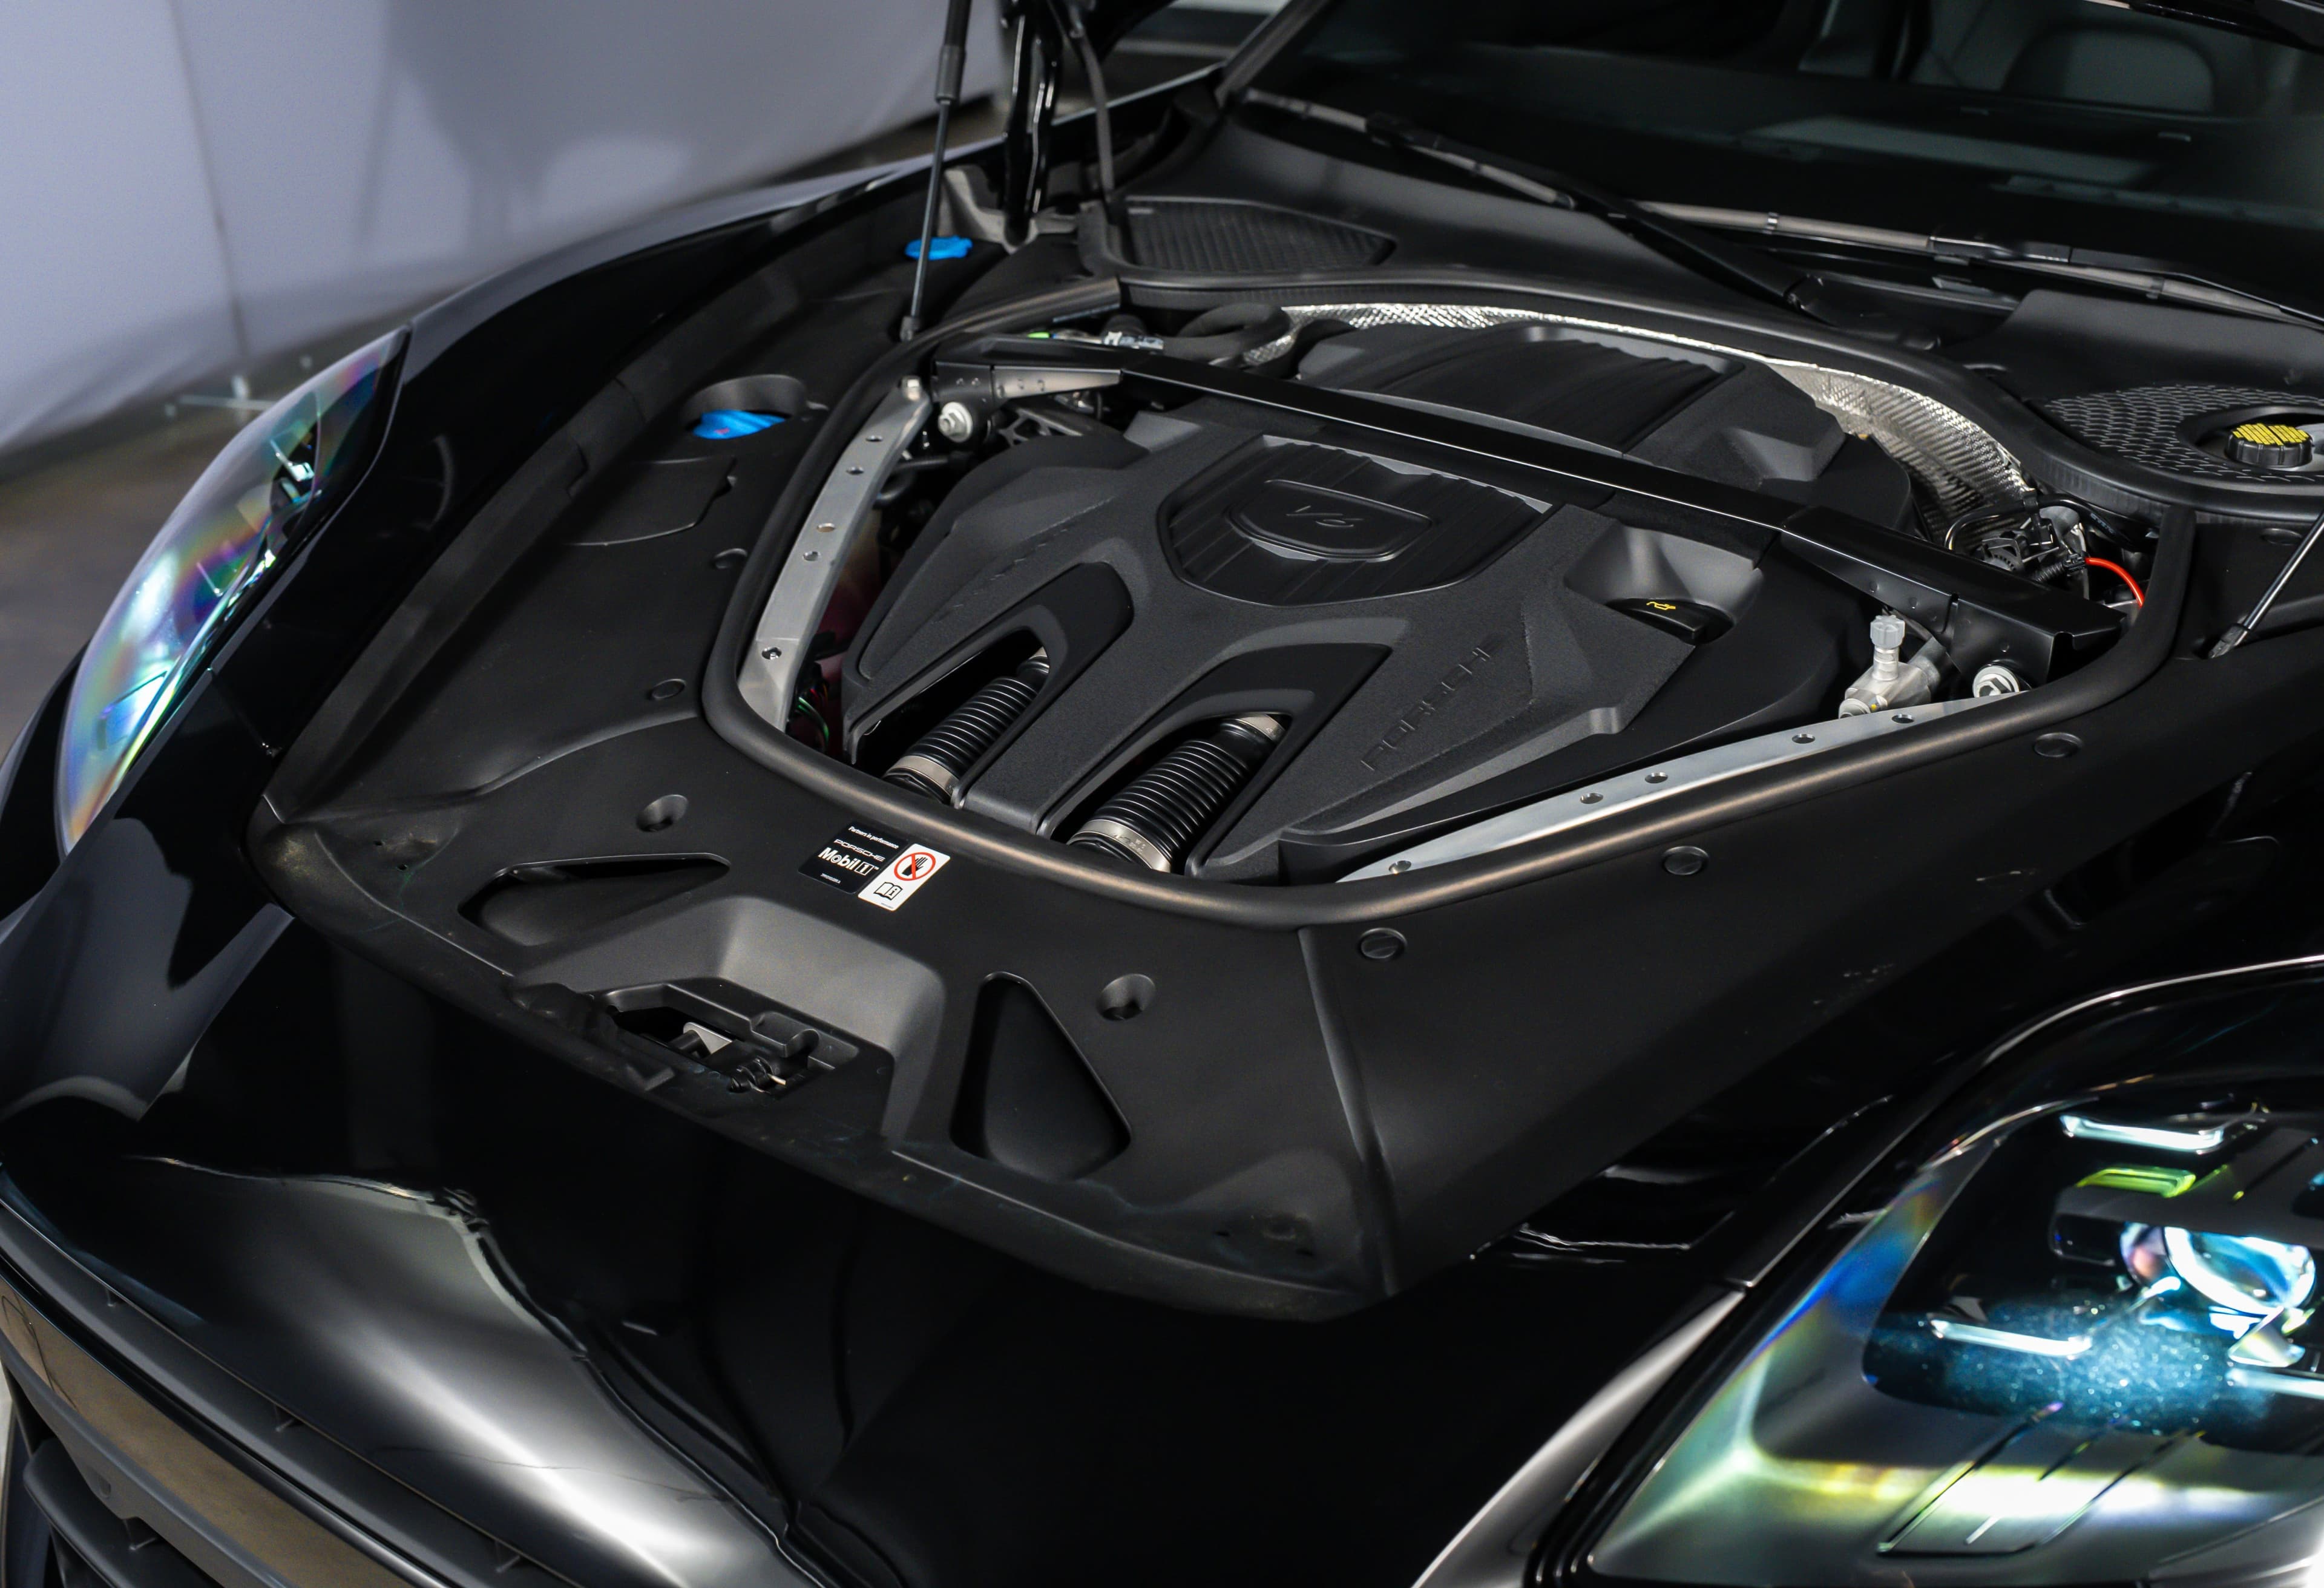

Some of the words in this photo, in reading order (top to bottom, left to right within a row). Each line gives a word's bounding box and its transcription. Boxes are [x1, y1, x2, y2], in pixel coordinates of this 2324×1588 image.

[1285, 505, 1364, 528] V6
[818, 847, 861, 870] Mobil
[833, 839, 885, 862] PORSCHE
